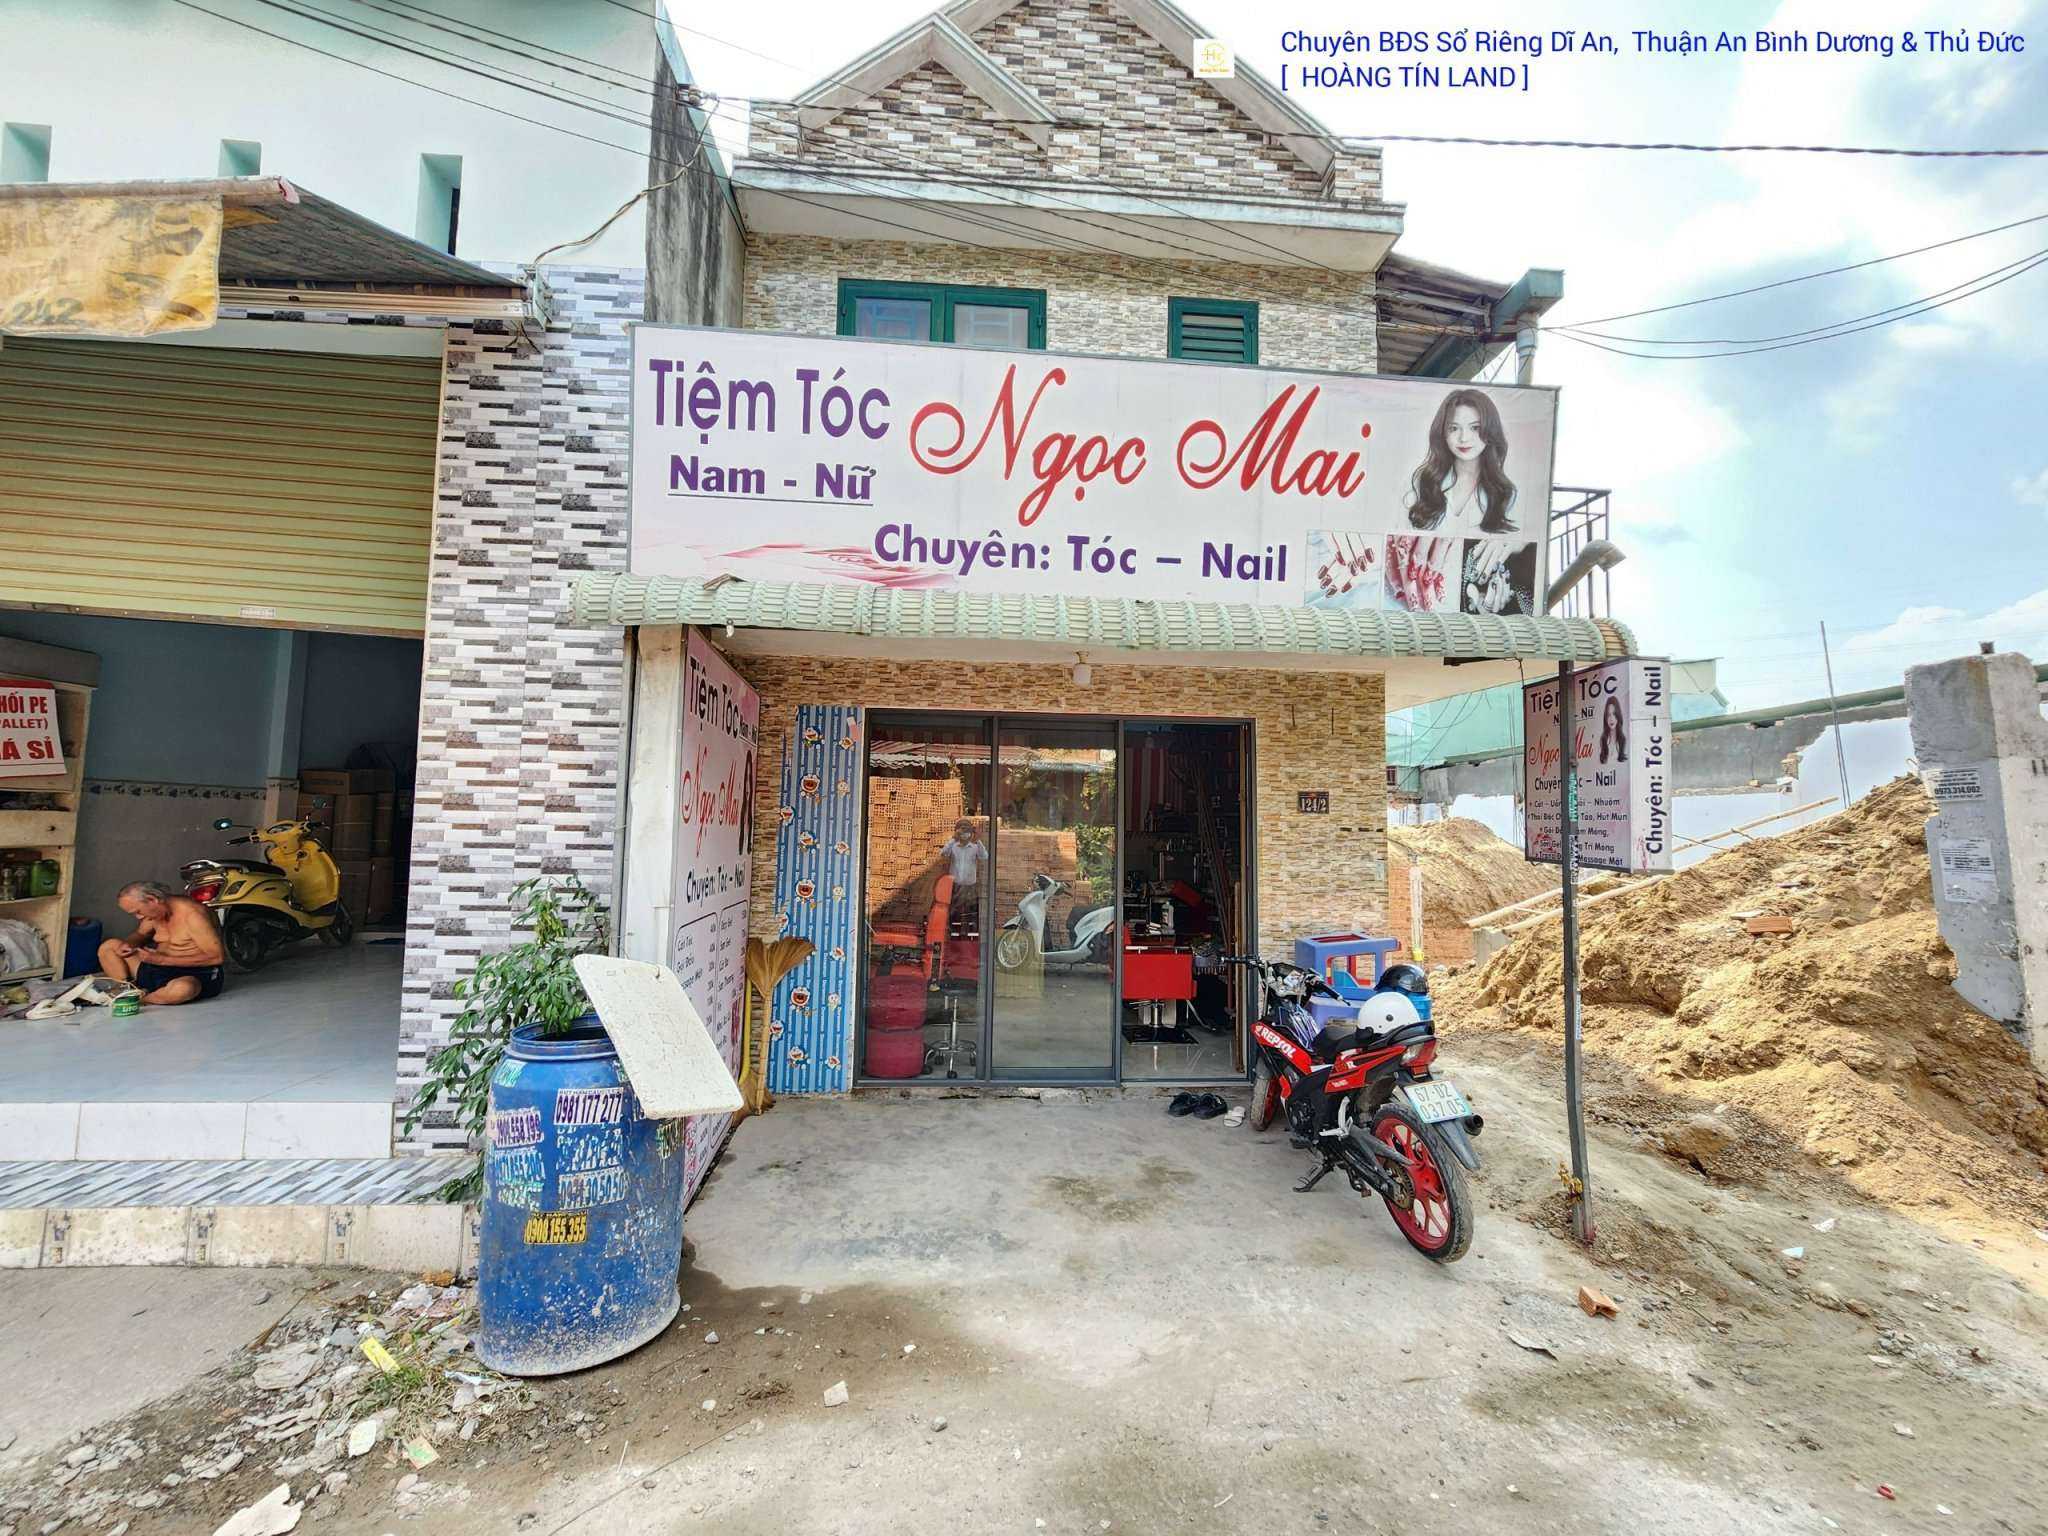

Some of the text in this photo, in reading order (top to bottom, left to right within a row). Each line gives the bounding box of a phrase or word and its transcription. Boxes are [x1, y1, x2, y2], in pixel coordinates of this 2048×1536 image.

[649, 358, 891, 445] Tiệm Tóc
[909, 362, 1373, 528] Ngọc Mai
[669, 454, 765, 495] Nam
[815, 462, 877, 501] Nữ
[874, 522, 1050, 577] Chuyên:
[1067, 533, 1137, 576] Tóc
[1202, 540, 1288, 583] Nail
[29, 696, 48, 714] PE
[690, 656, 718, 732] Tiệm
[722, 683, 739, 740] Tóc
[1531, 674, 1617, 714] Tiệ Tóc
[1643, 666, 1661, 706] Nail
[0, 718, 49, 731] ALLET)
[0, 735, 55, 760] Á SỈ
[1644, 735, 1663, 768] Tóc
[1596, 770, 1617, 786] Nail
[1301, 798, 1327, 812] 124/2
[1643, 775, 1667, 855] Chuyên:
[1260, 1026, 1297, 1059] REPSOL
